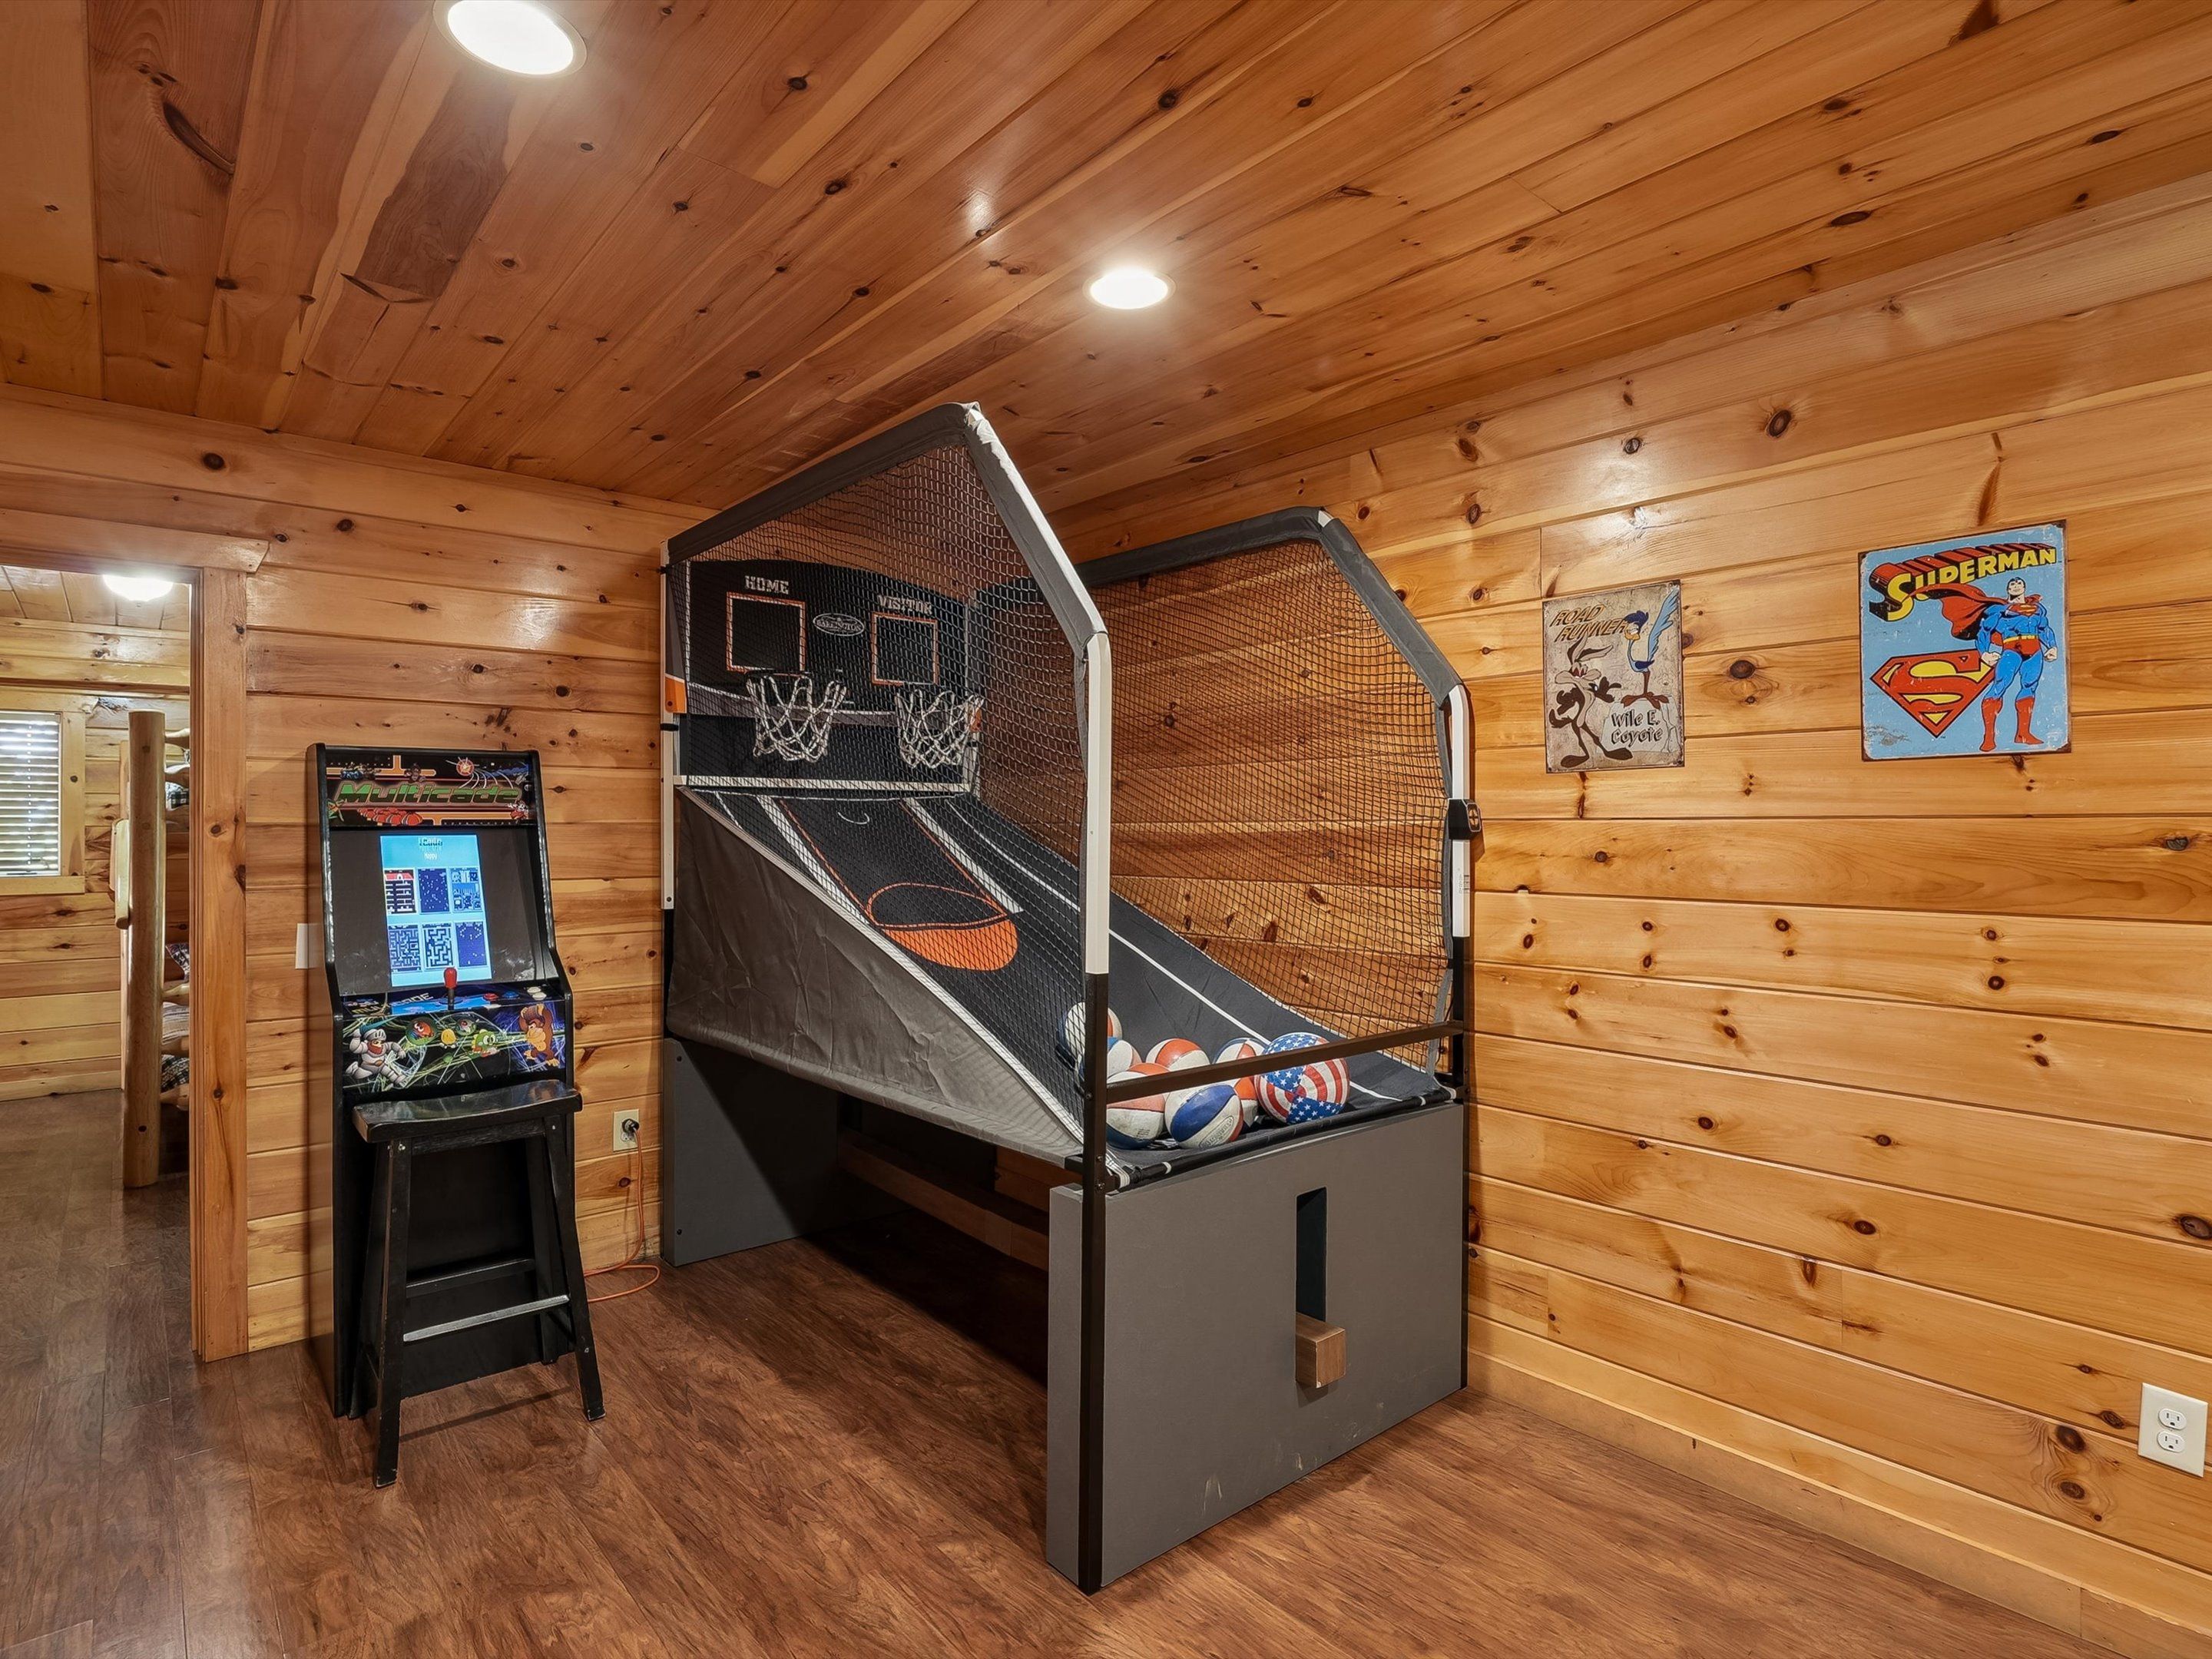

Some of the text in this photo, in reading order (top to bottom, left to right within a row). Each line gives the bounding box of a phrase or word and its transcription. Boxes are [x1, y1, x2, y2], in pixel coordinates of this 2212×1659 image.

[745, 575, 789, 594] HOME
[1869, 542, 2058, 622] SUPERMAN
[877, 594, 932, 614] VISITOR
[1550, 604, 1605, 627] ROAD
[1555, 618, 1628, 642] RUNNER
[1611, 709, 1661, 727] Wile E.
[1611, 727, 1663, 747] Coyote
[334, 783, 522, 804] Multicade
